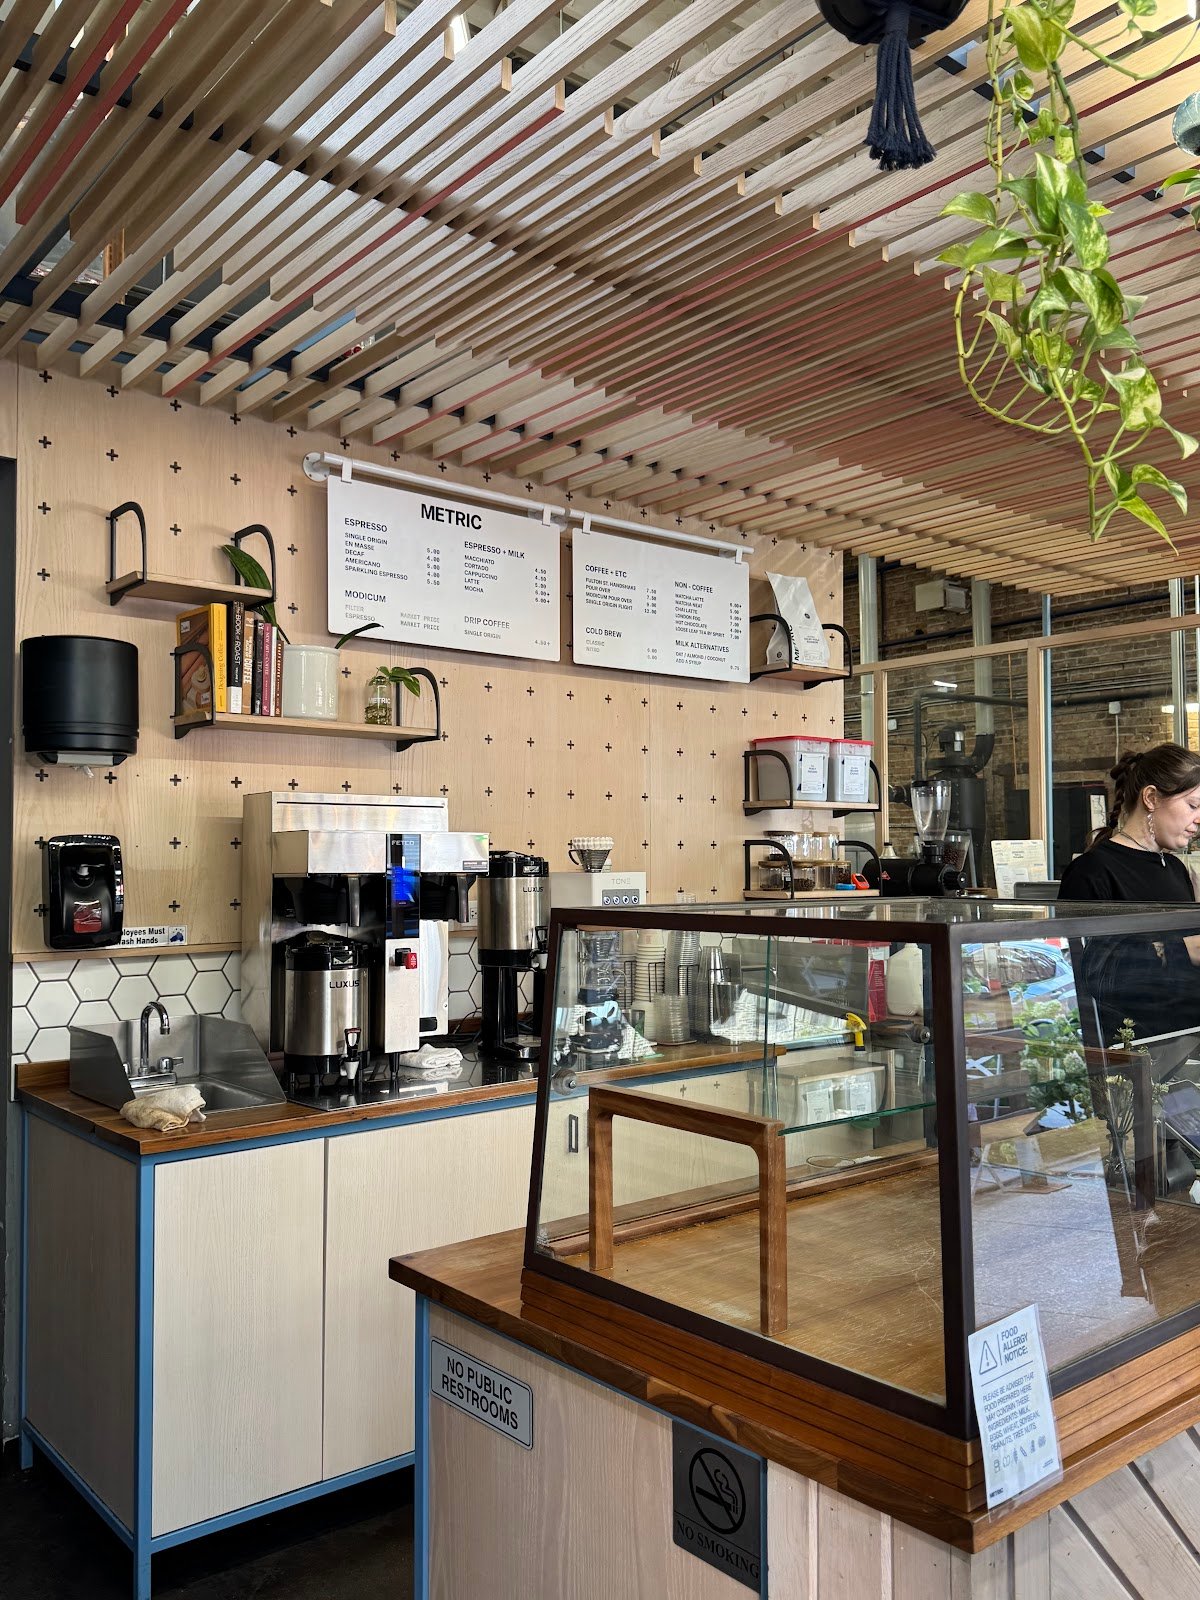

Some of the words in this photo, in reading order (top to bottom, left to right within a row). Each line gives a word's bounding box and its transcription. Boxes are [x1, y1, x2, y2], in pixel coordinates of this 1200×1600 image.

[421, 503, 482, 530] METRIC
[344, 518, 388, 532] ESPRESSO
[344, 532, 366, 541] SINGLE
[367, 536, 388, 545] ORIGIN
[345, 548, 365, 556] DECAF
[354, 542, 374, 550] MASSE
[464, 541, 501, 554] ESPRESSO
[508, 549, 525, 559] MILK
[345, 557, 381, 568] AMERICANO
[464, 555, 494, 565] MACCHIATO
[345, 565, 378, 575] SPARKLING
[379, 571, 408, 580] ESPRESSO
[464, 562, 489, 572] CORTADO
[585, 564, 609, 575] COFFEE
[615, 570, 627, 578] ETC
[464, 570, 497, 580] CAPPUCCINO
[464, 585, 484, 593] MOCHA
[674, 581, 687, 589] NON
[692, 584, 713, 594] COFFEE
[345, 589, 386, 602] MODICUM
[585, 598, 601, 606] SINGLE
[345, 612, 376, 621] ESPRESSO
[400, 620, 420, 628] MARKET
[424, 623, 440, 631] PRICE
[400, 612, 420, 620] MARKET
[464, 616, 481, 625] DRIP
[482, 619, 510, 629] COFFEE
[684, 621, 707, 629] CHOCOLATE
[464, 629, 482, 637] SINGLE
[483, 632, 501, 640] ORIGIN
[585, 626, 603, 636] COLD
[604, 629, 622, 638] BREW
[690, 642, 729, 653] ALTERNATIVES
[687, 652, 704, 660] ALMOND
[244, 658, 252, 685] COFFEE
[121, 928, 147, 937] loyees
[148, 927, 165, 935] Must
[329, 979, 360, 989] LUXUS
[1001, 1325, 1018, 1341] FOOD
[1003, 1333, 1028, 1352] ALLERGY
[1004, 1345, 1028, 1364] NOTICE:
[447, 1356, 464, 1379] NO
[467, 1366, 512, 1404] PUBLIC
[982, 1389, 999, 1402] PLEASE
[1000, 1385, 1006, 1393] BE
[1006, 1378, 1023, 1391] ADVISED
[1024, 1371, 1034, 1381] THAT
[442, 1373, 518, 1430] RESTROOMS
[984, 1401, 997, 1413] FOOD
[997, 1389, 1020, 1406] PREPARED
[1020, 1383, 1032, 1393] HERE
[986, 1412, 996, 1423] MAY
[996, 1403, 1016, 1418] CONTAIN
[1016, 1395, 1030, 1406] THESE
[1013, 1431, 1024, 1440] TREE
[677, 1519, 694, 1541] NO
[697, 1532, 759, 1579] SMOKING
